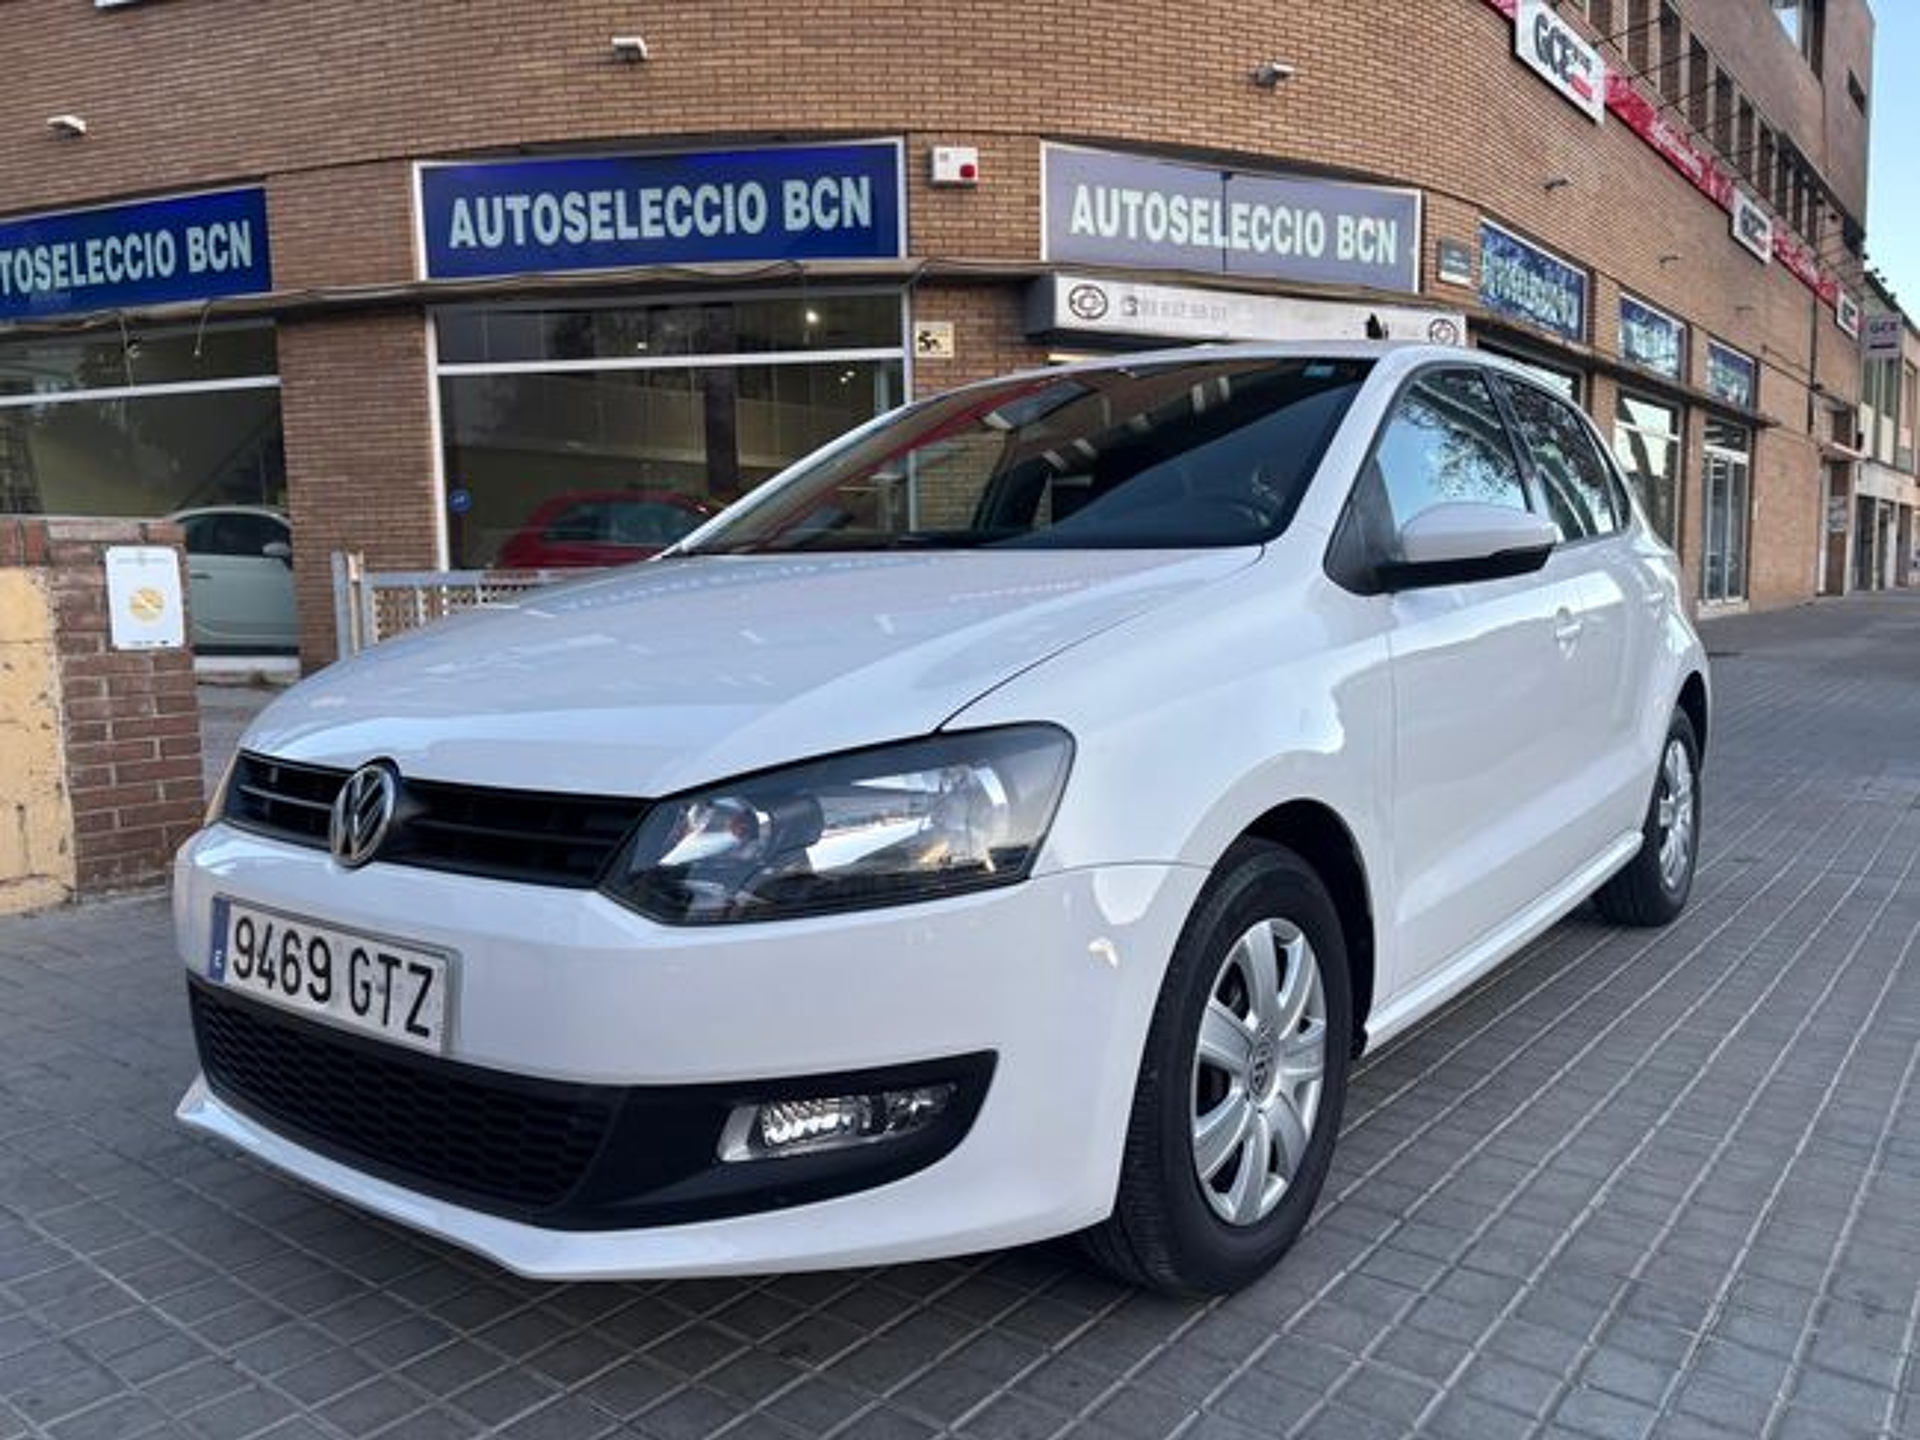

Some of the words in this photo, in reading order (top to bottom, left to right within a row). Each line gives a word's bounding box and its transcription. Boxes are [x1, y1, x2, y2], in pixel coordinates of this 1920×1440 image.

[186, 220, 253, 274] BCN
[449, 181, 767, 249] AUTOSELECCIO
[783, 176, 873, 232] BCN
[1070, 184, 1326, 258] AUTOSELECCIO
[1336, 215, 1399, 265] BCN
[233, 916, 333, 1004] 9469
[348, 946, 435, 1038] GTZ
